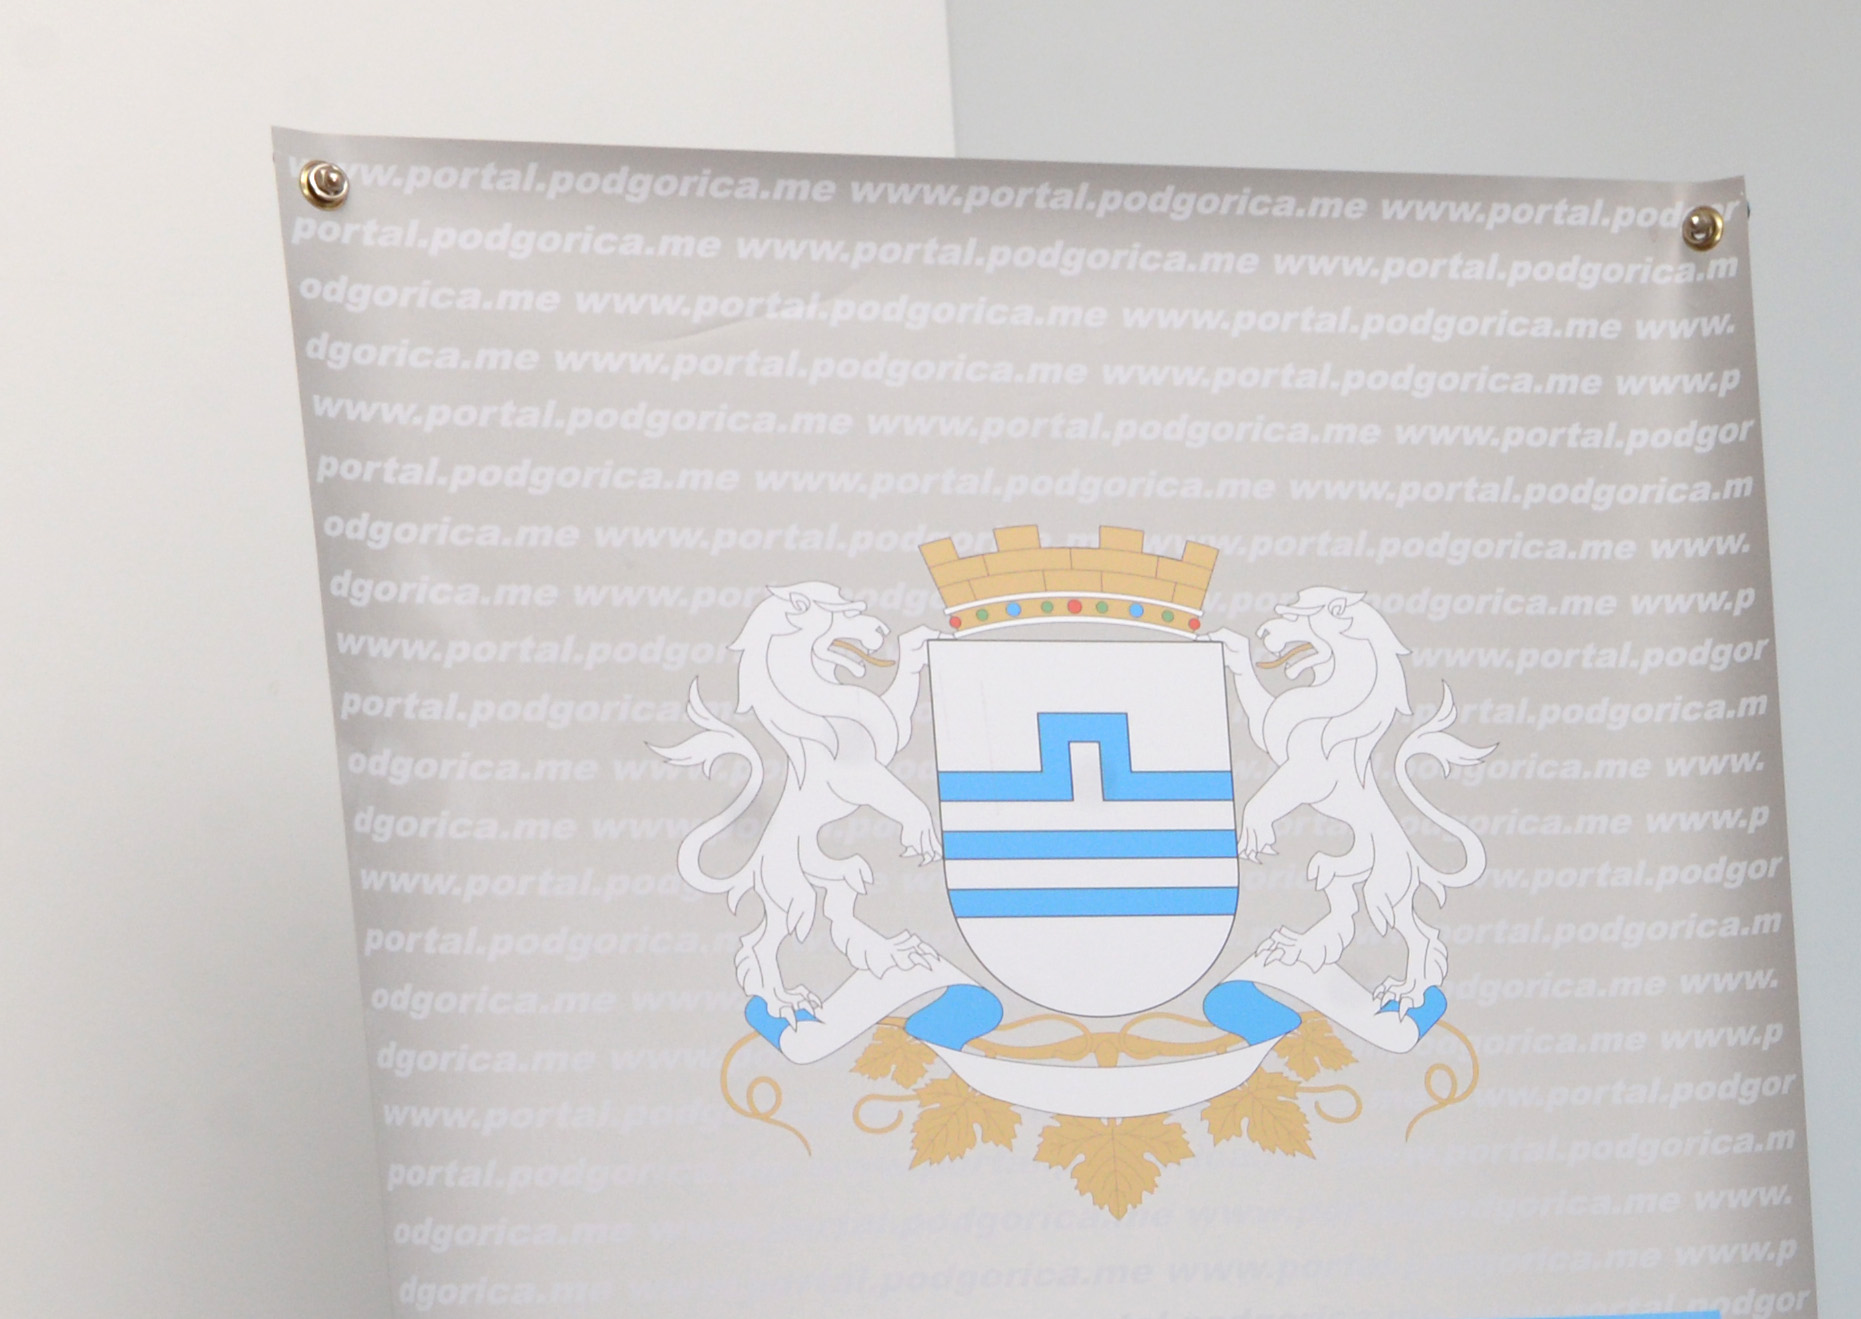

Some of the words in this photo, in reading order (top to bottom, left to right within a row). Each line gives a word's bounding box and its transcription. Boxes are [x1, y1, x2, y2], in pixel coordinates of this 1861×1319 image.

[850, 180, 1367, 221] www.portal.podgorica.me
[1381, 196, 1739, 232] www.portal.podr
[291, 217, 721, 259] portal.podgorica.me
[737, 236, 1258, 277] www.portal.podgorica.me
[1273, 252, 1738, 289] www.portal.podgorica.m
[300, 275, 560, 313] odgorica.me
[575, 290, 1107, 330] www.portal.podgorica.me
[1121, 306, 1621, 342] www.portal.podgorica.me
[306, 332, 540, 370] dgorica.me
[554, 349, 1087, 388] www.portal.podgorica.me
[1102, 362, 1602, 399] www.portal.podgorica.me
[1615, 367, 1740, 397] www.p
[312, 393, 853, 439] www.portal.podgorica.me
[867, 411, 1381, 449] www.portal.podgorica.me
[1395, 417, 1754, 455] www.portal.podgor
[317, 454, 739, 495] portal.podgorica.me
[754, 467, 1275, 503] www.portal.podgorica.me
[1289, 474, 1753, 511] www.portal.podgorica.m
[324, 512, 580, 551] odgorica.me
[330, 569, 559, 608] dgorica.me
[1411, 637, 1768, 674] www.portal.podgor
[347, 748, 598, 785] odgorica.me
[354, 805, 577, 843] dgorica.me
[371, 983, 617, 1020] odgorica.me
